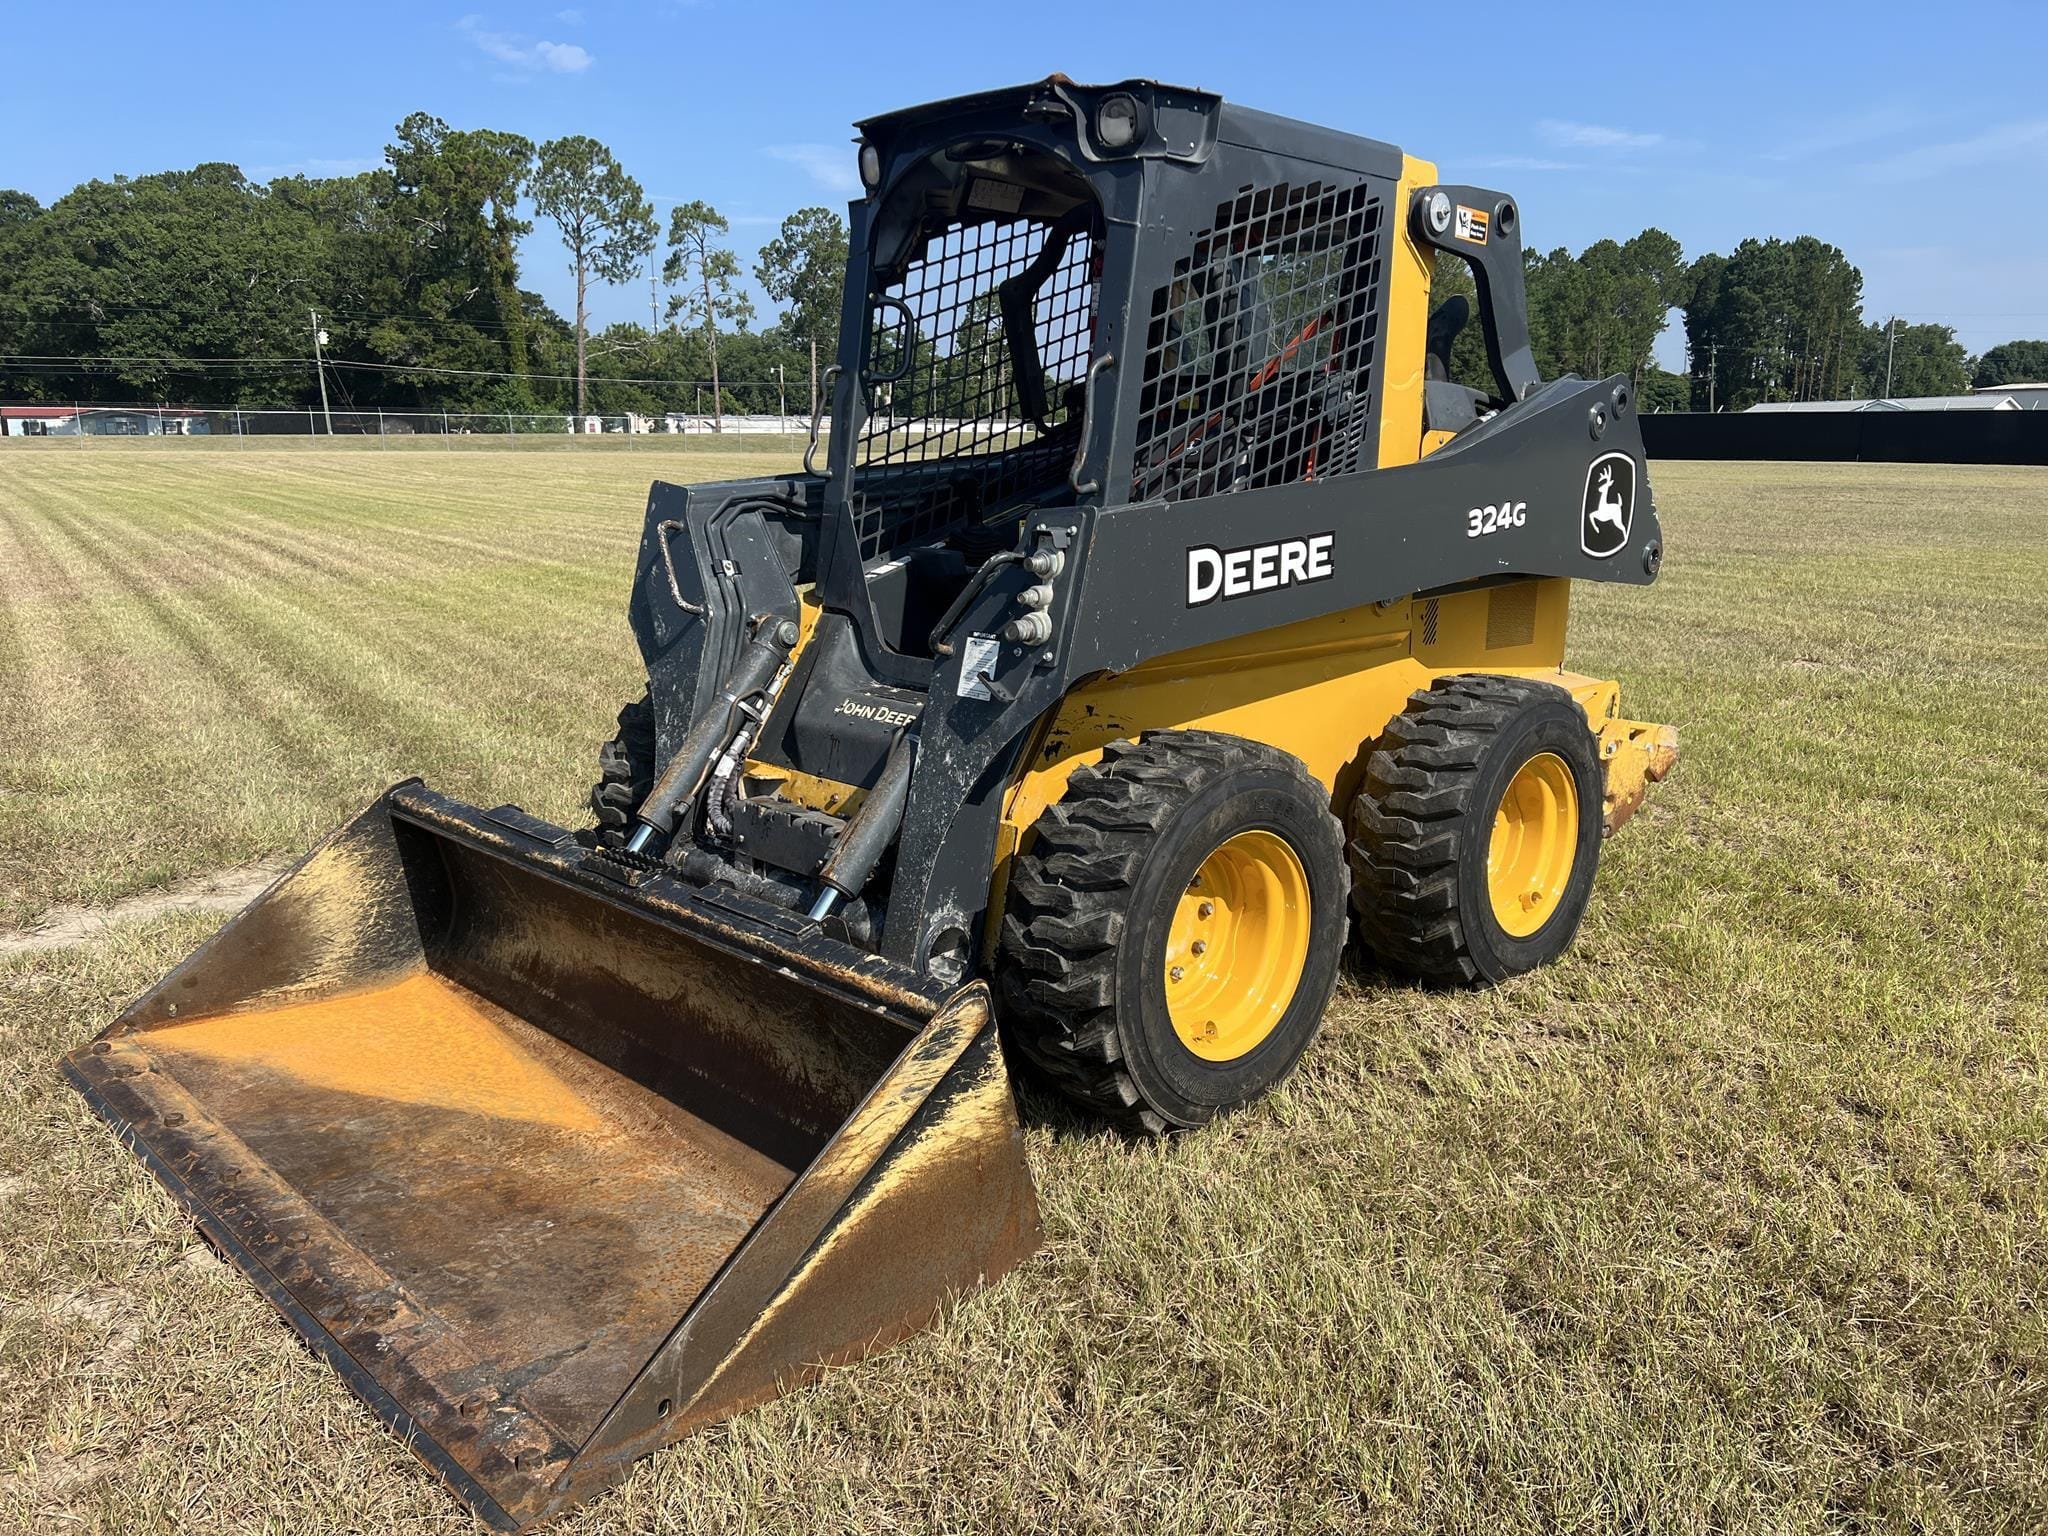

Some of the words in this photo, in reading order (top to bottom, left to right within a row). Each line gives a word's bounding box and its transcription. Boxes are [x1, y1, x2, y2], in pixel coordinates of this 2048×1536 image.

[1467, 502, 1527, 538] 324G
[1187, 535, 1333, 604] DEERE
[834, 699, 875, 719] JOHN
